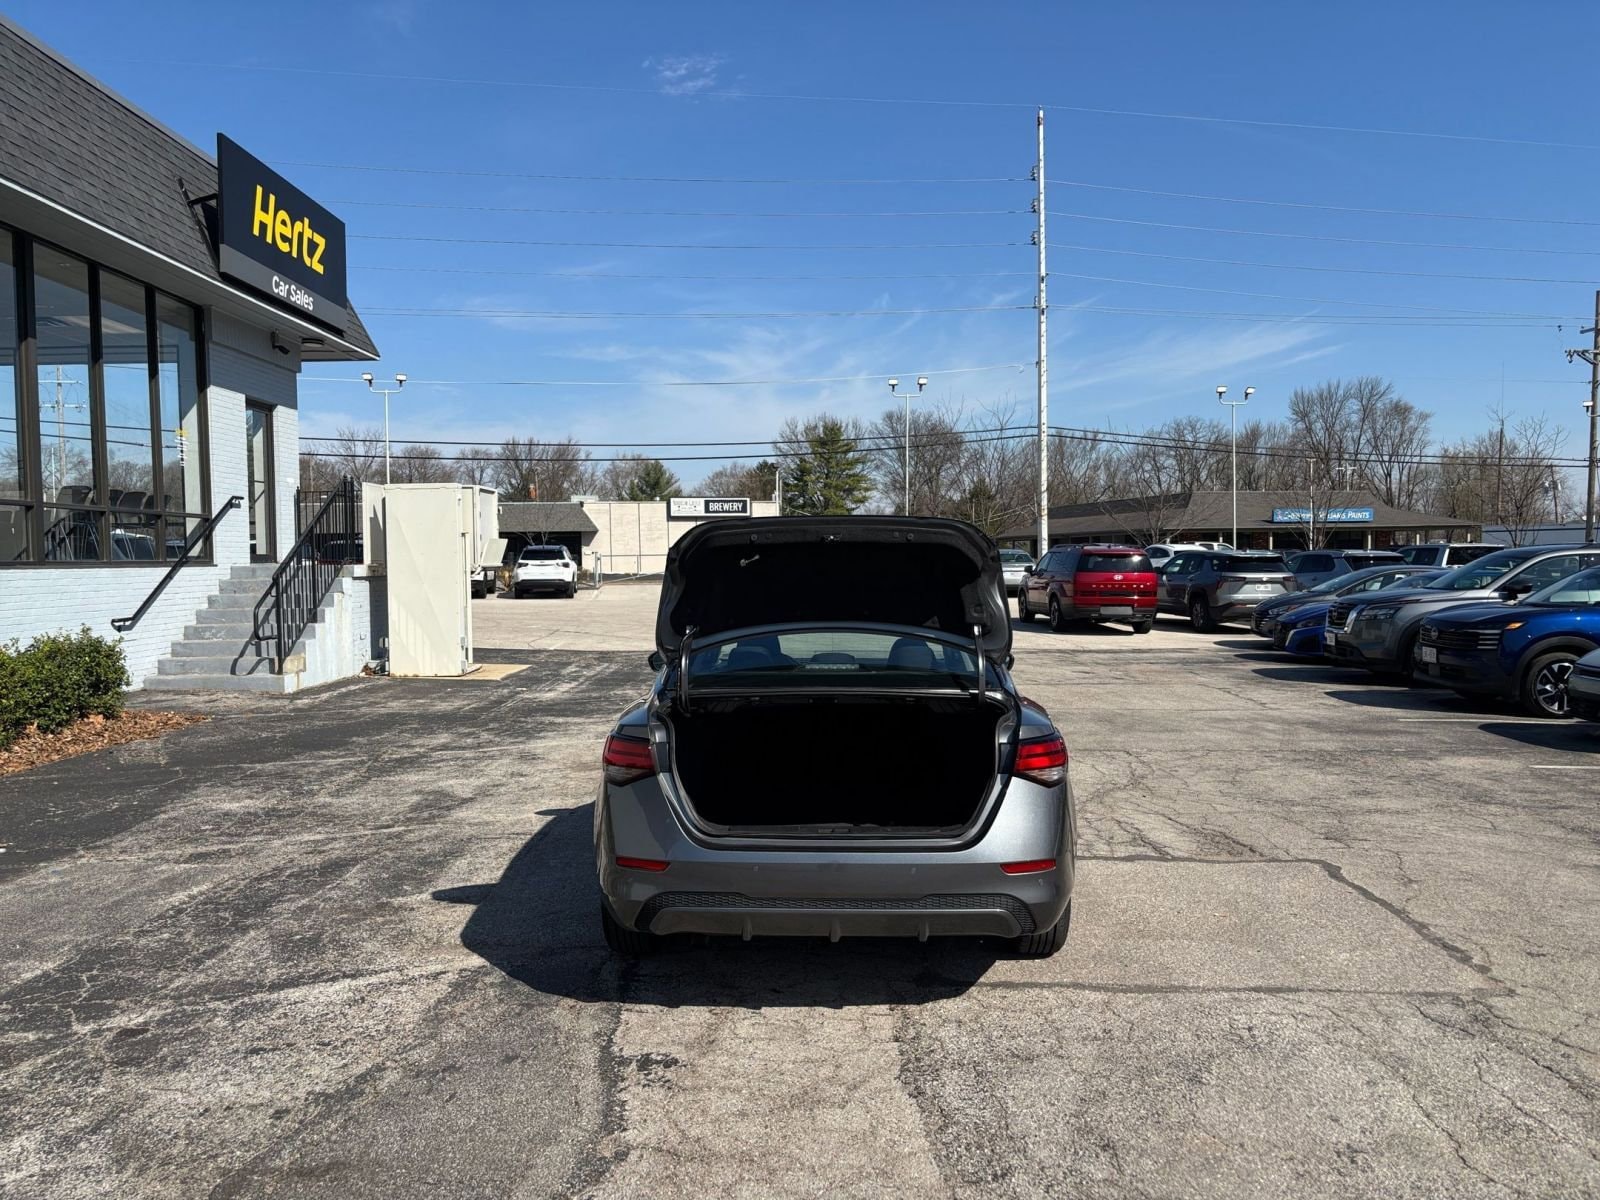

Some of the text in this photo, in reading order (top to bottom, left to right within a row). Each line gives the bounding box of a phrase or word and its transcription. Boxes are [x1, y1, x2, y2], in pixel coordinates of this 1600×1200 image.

[253, 184, 326, 275] Hertz
[272, 275, 314, 311] Car Sales
[708, 502, 743, 512] BREWERY
